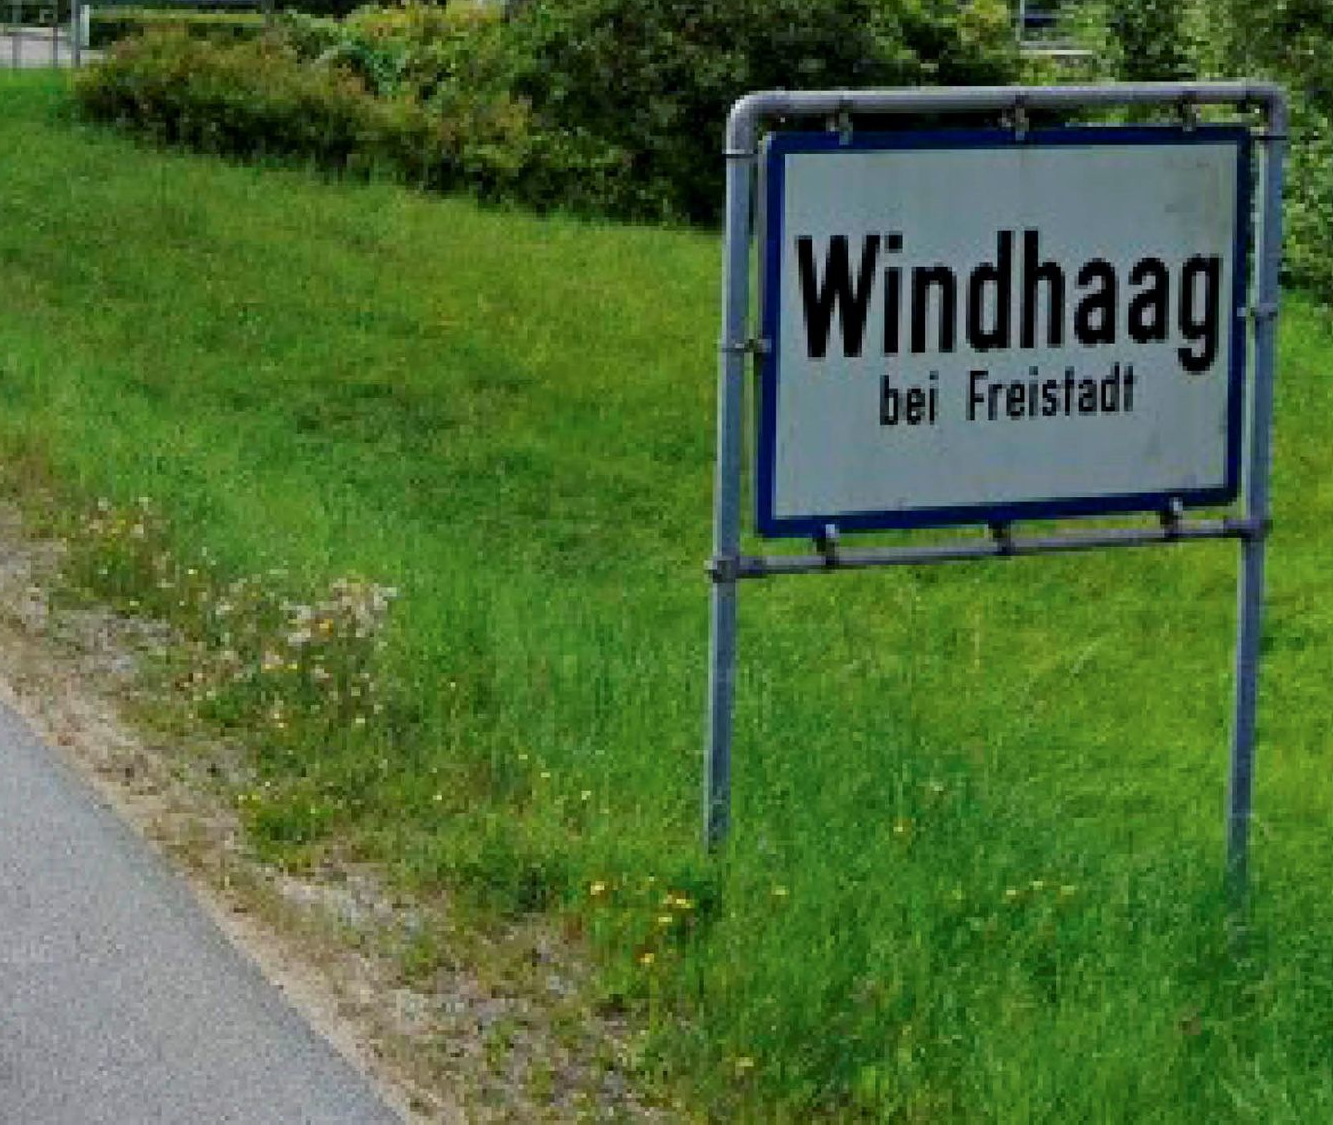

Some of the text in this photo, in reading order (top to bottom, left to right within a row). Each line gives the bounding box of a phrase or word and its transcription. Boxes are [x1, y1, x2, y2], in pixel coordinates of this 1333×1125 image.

[795, 228, 1222, 373] Windhaag
[879, 363, 1136, 426] bei Freistadt
